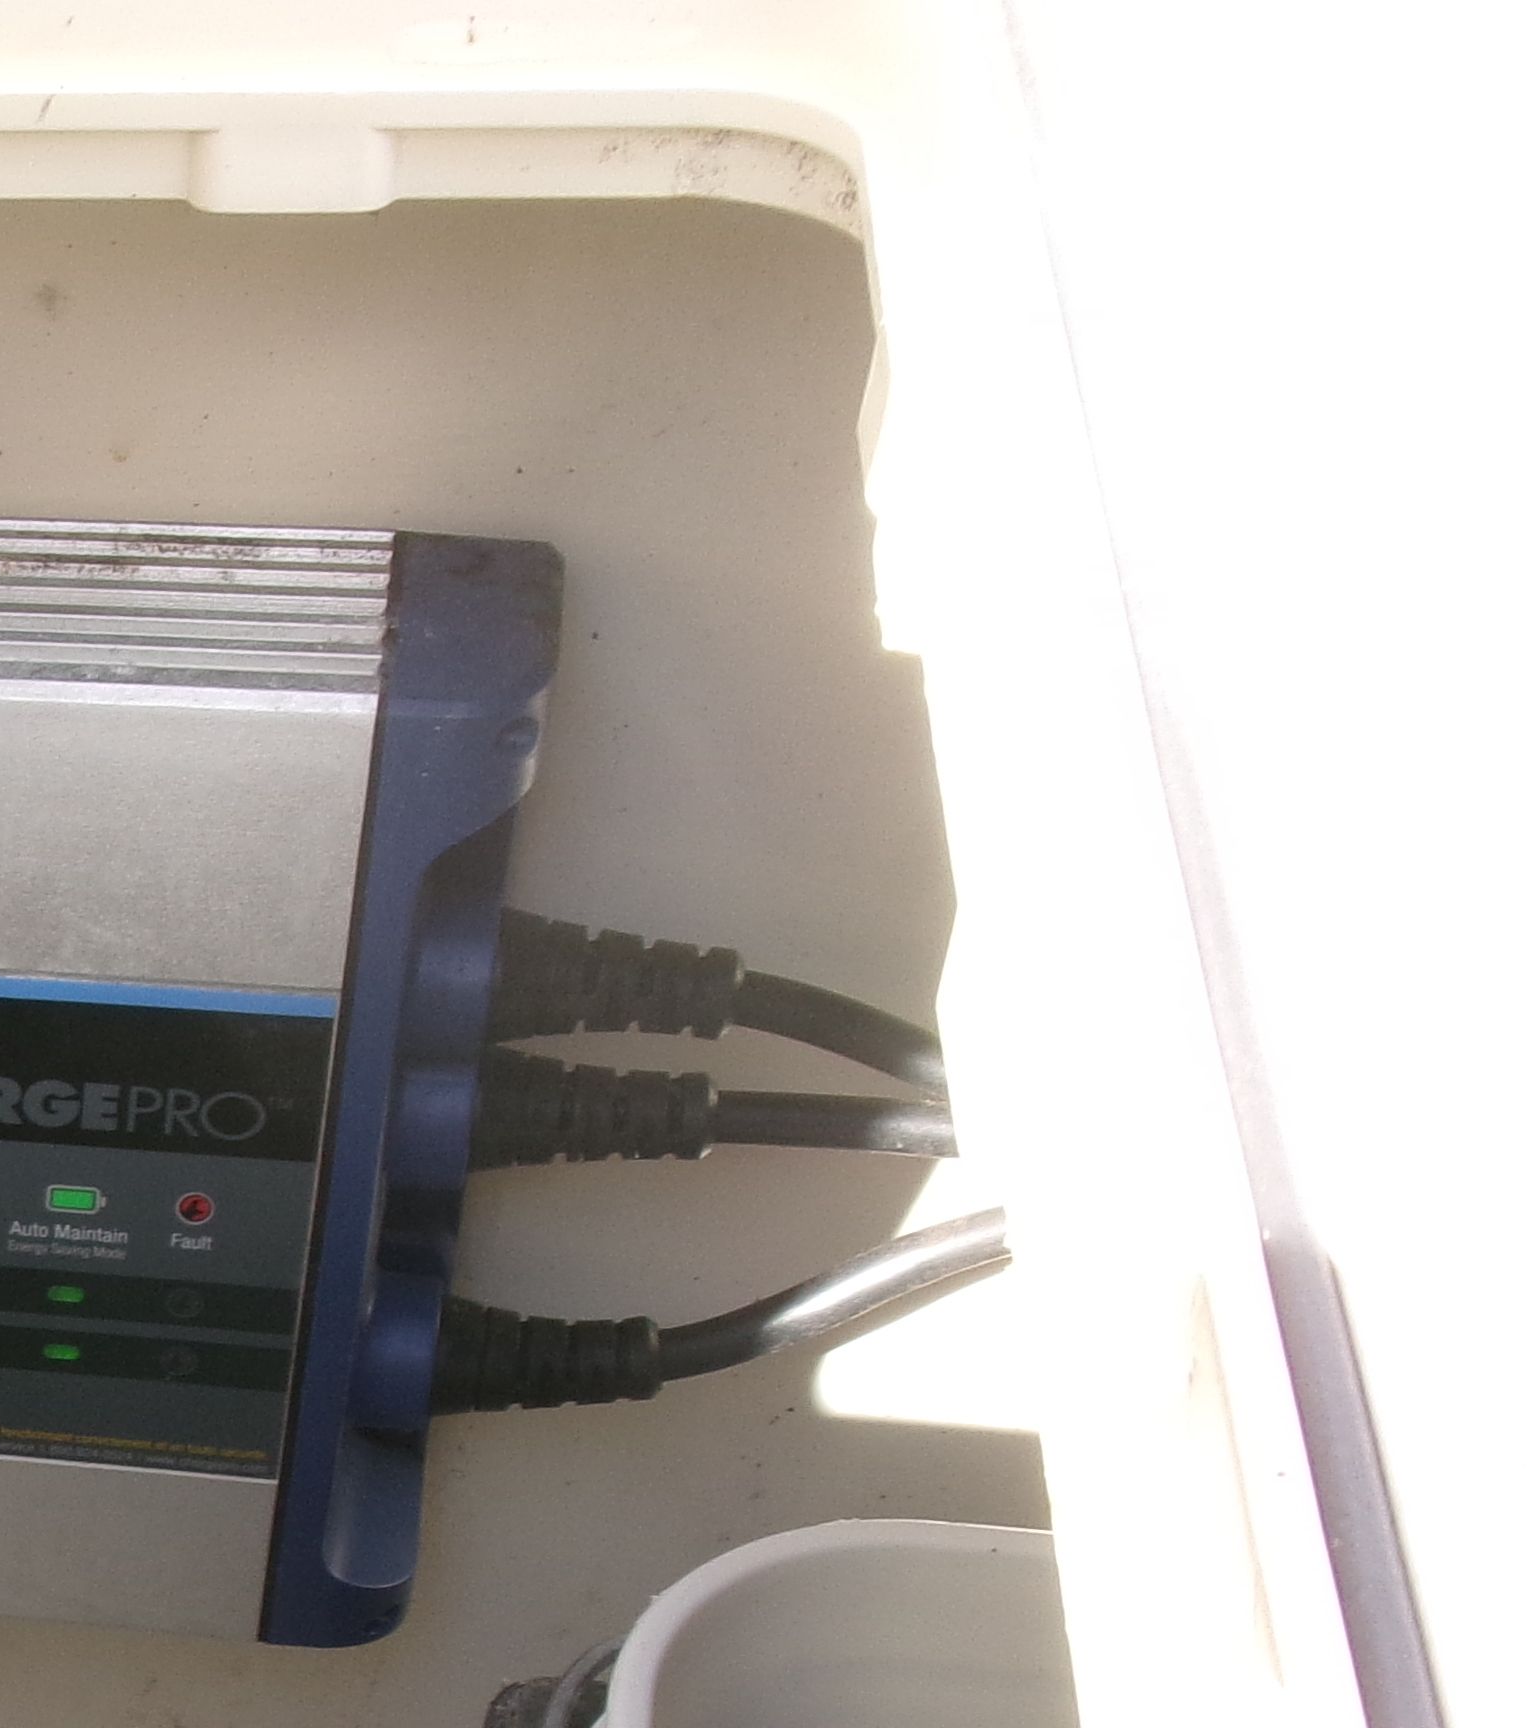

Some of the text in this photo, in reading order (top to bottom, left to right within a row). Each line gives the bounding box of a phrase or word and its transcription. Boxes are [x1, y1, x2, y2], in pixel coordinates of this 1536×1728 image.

[9, 1220, 129, 1244] Auto Maintain
[170, 1233, 213, 1250] Fault
[8, 1240, 128, 1260] Energy Saving Mode
